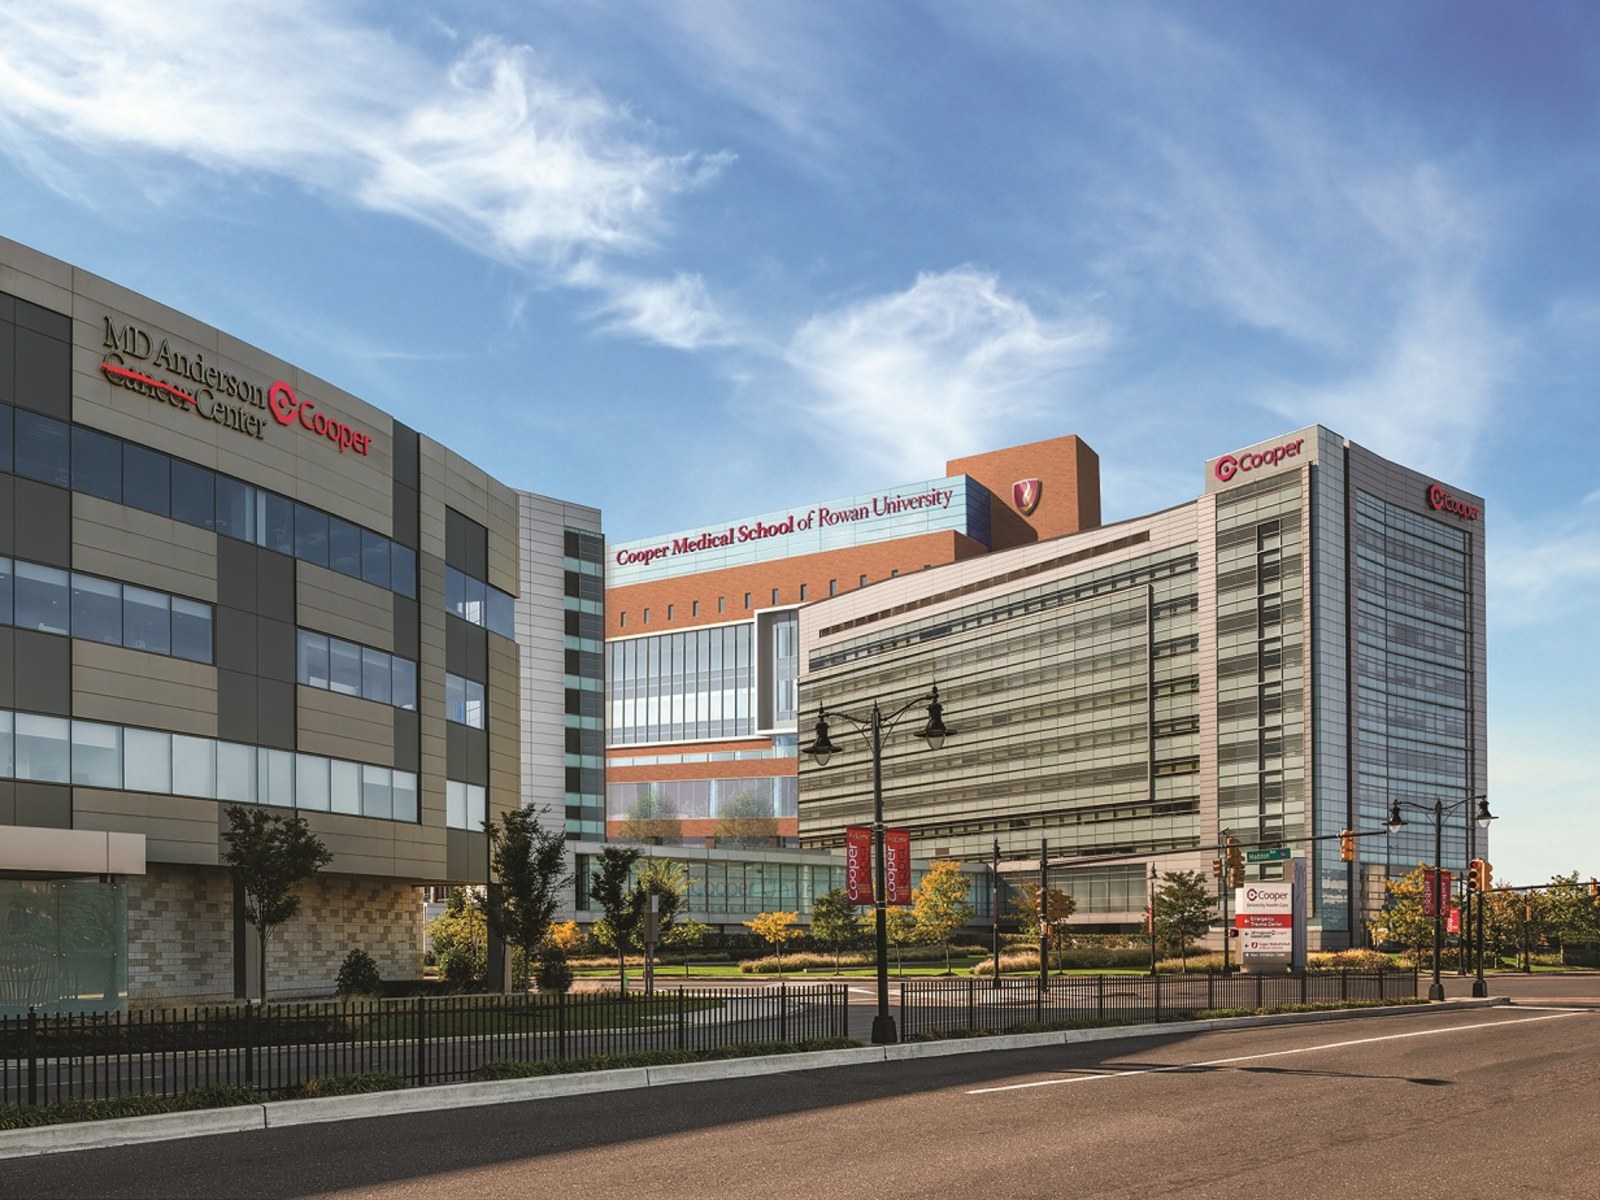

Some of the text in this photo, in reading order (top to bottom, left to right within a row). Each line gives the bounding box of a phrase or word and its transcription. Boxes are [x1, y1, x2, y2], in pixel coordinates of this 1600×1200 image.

[103, 315, 267, 409] MD Anderson
[195, 388, 268, 440] Center
[300, 401, 372, 456] Cooper
[1238, 439, 1304, 471] Cooper
[615, 487, 953, 566] Cooper Medical School of Rowan University
[1445, 493, 1481, 521] Cooper
[848, 842, 859, 900] Cooper
[887, 845, 898, 902] Cooper
[1258, 890, 1288, 901] Cooper
